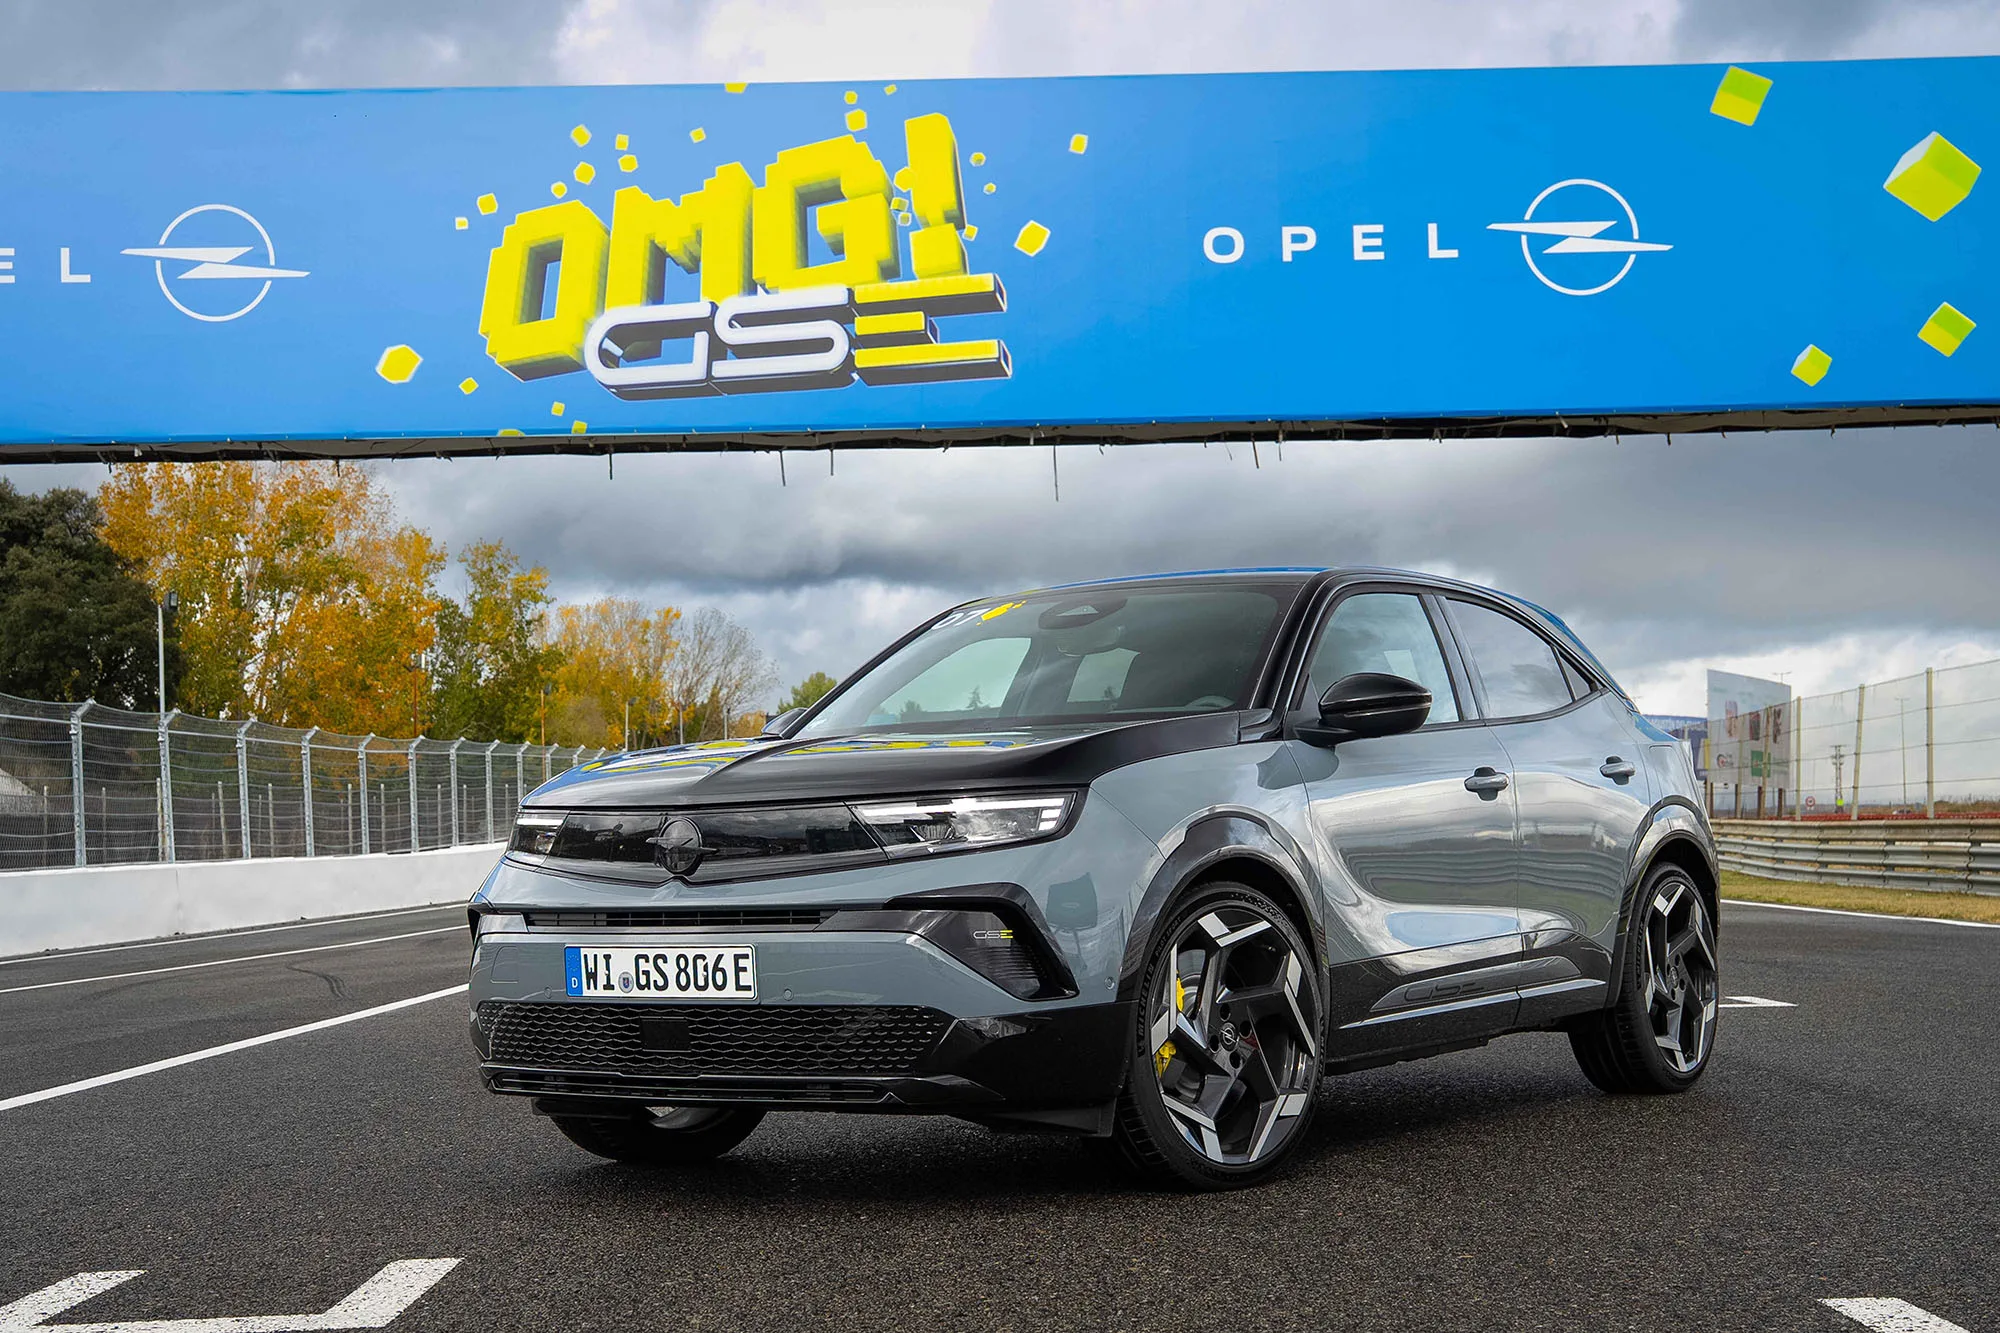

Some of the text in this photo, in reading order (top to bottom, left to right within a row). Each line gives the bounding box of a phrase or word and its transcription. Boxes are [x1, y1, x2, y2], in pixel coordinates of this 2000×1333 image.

[478, 112, 970, 382] OMG!
[1203, 223, 1459, 264] OPEL
[583, 272, 1012, 401] GSE
[973, 930, 1014, 939] GSE
[572, 977, 578, 988] D
[584, 953, 616, 990] WI
[1138, 963, 1156, 1038] MICHELIN
